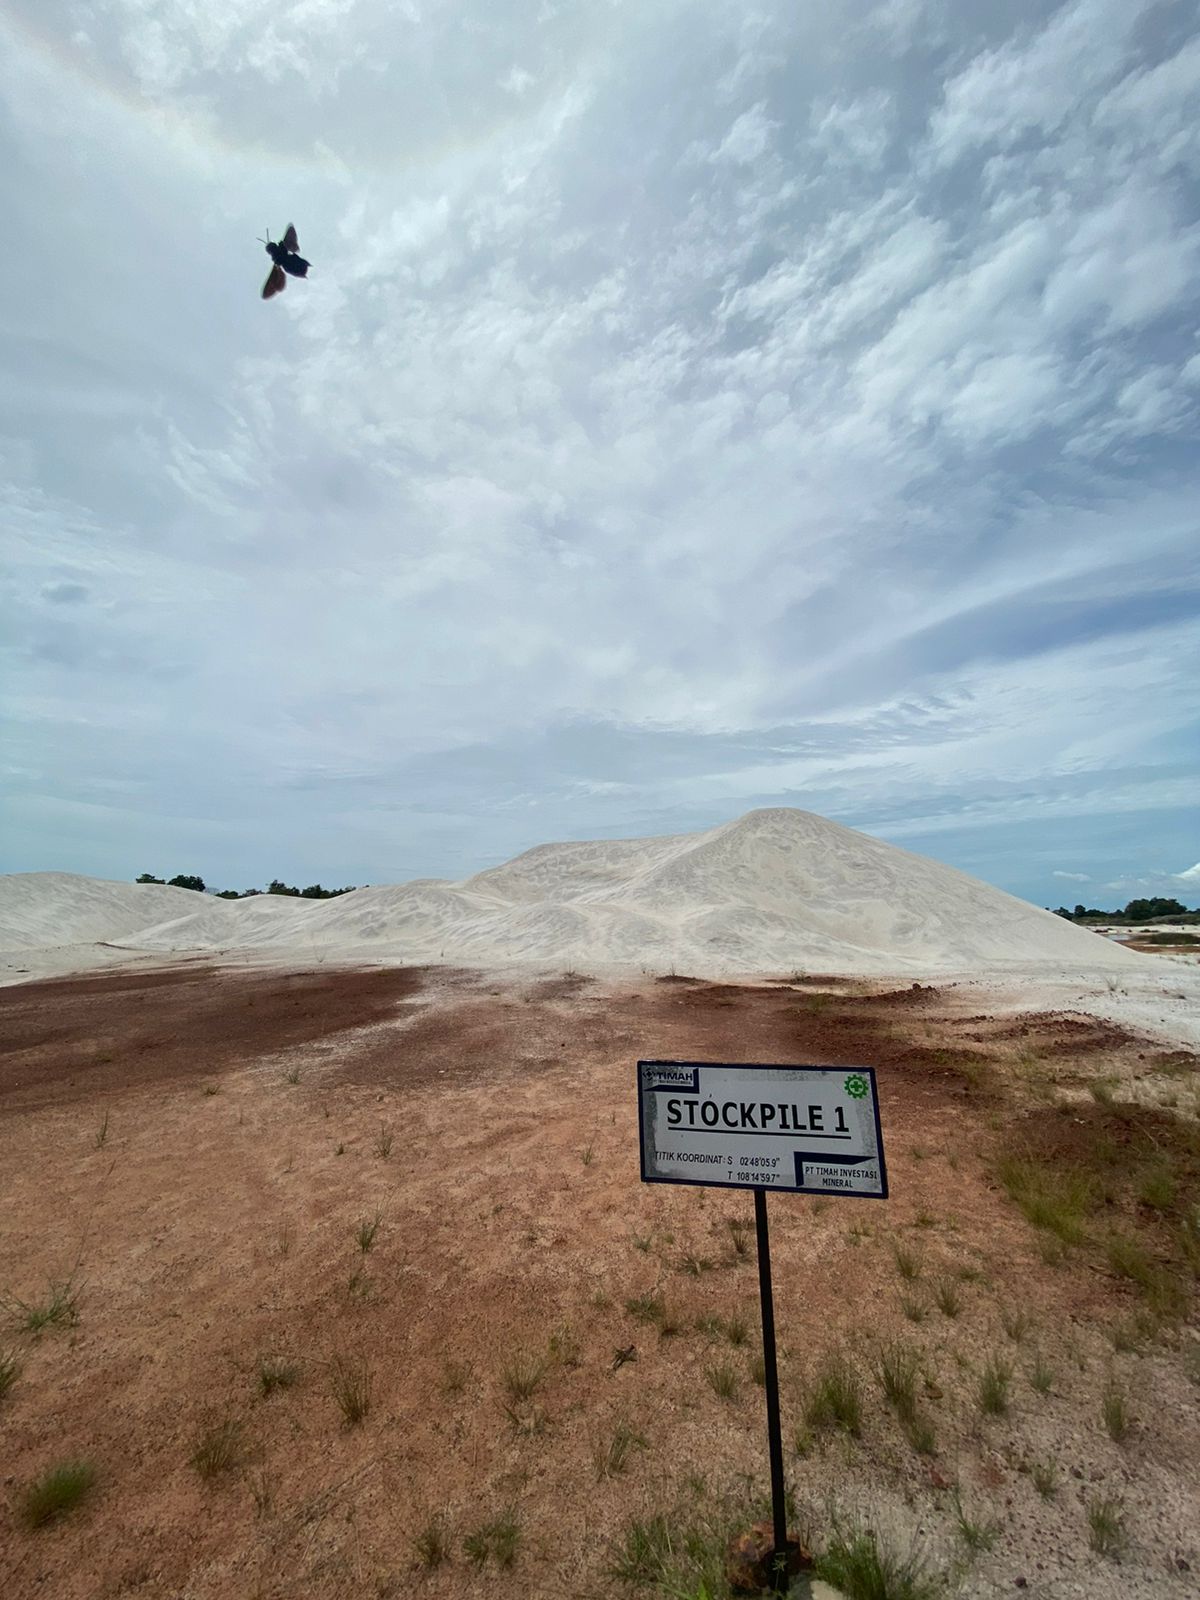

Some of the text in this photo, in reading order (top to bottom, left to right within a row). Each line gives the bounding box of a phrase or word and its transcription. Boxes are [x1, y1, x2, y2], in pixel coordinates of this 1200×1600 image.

[657, 1072, 692, 1080] TIMAH
[667, 1099, 849, 1132] STOCKPILE 1
[728, 1171, 733, 1179] T
[805, 1166, 877, 1180] PT TIMAH INVESTASI
[822, 1178, 853, 1188] MINERAL
